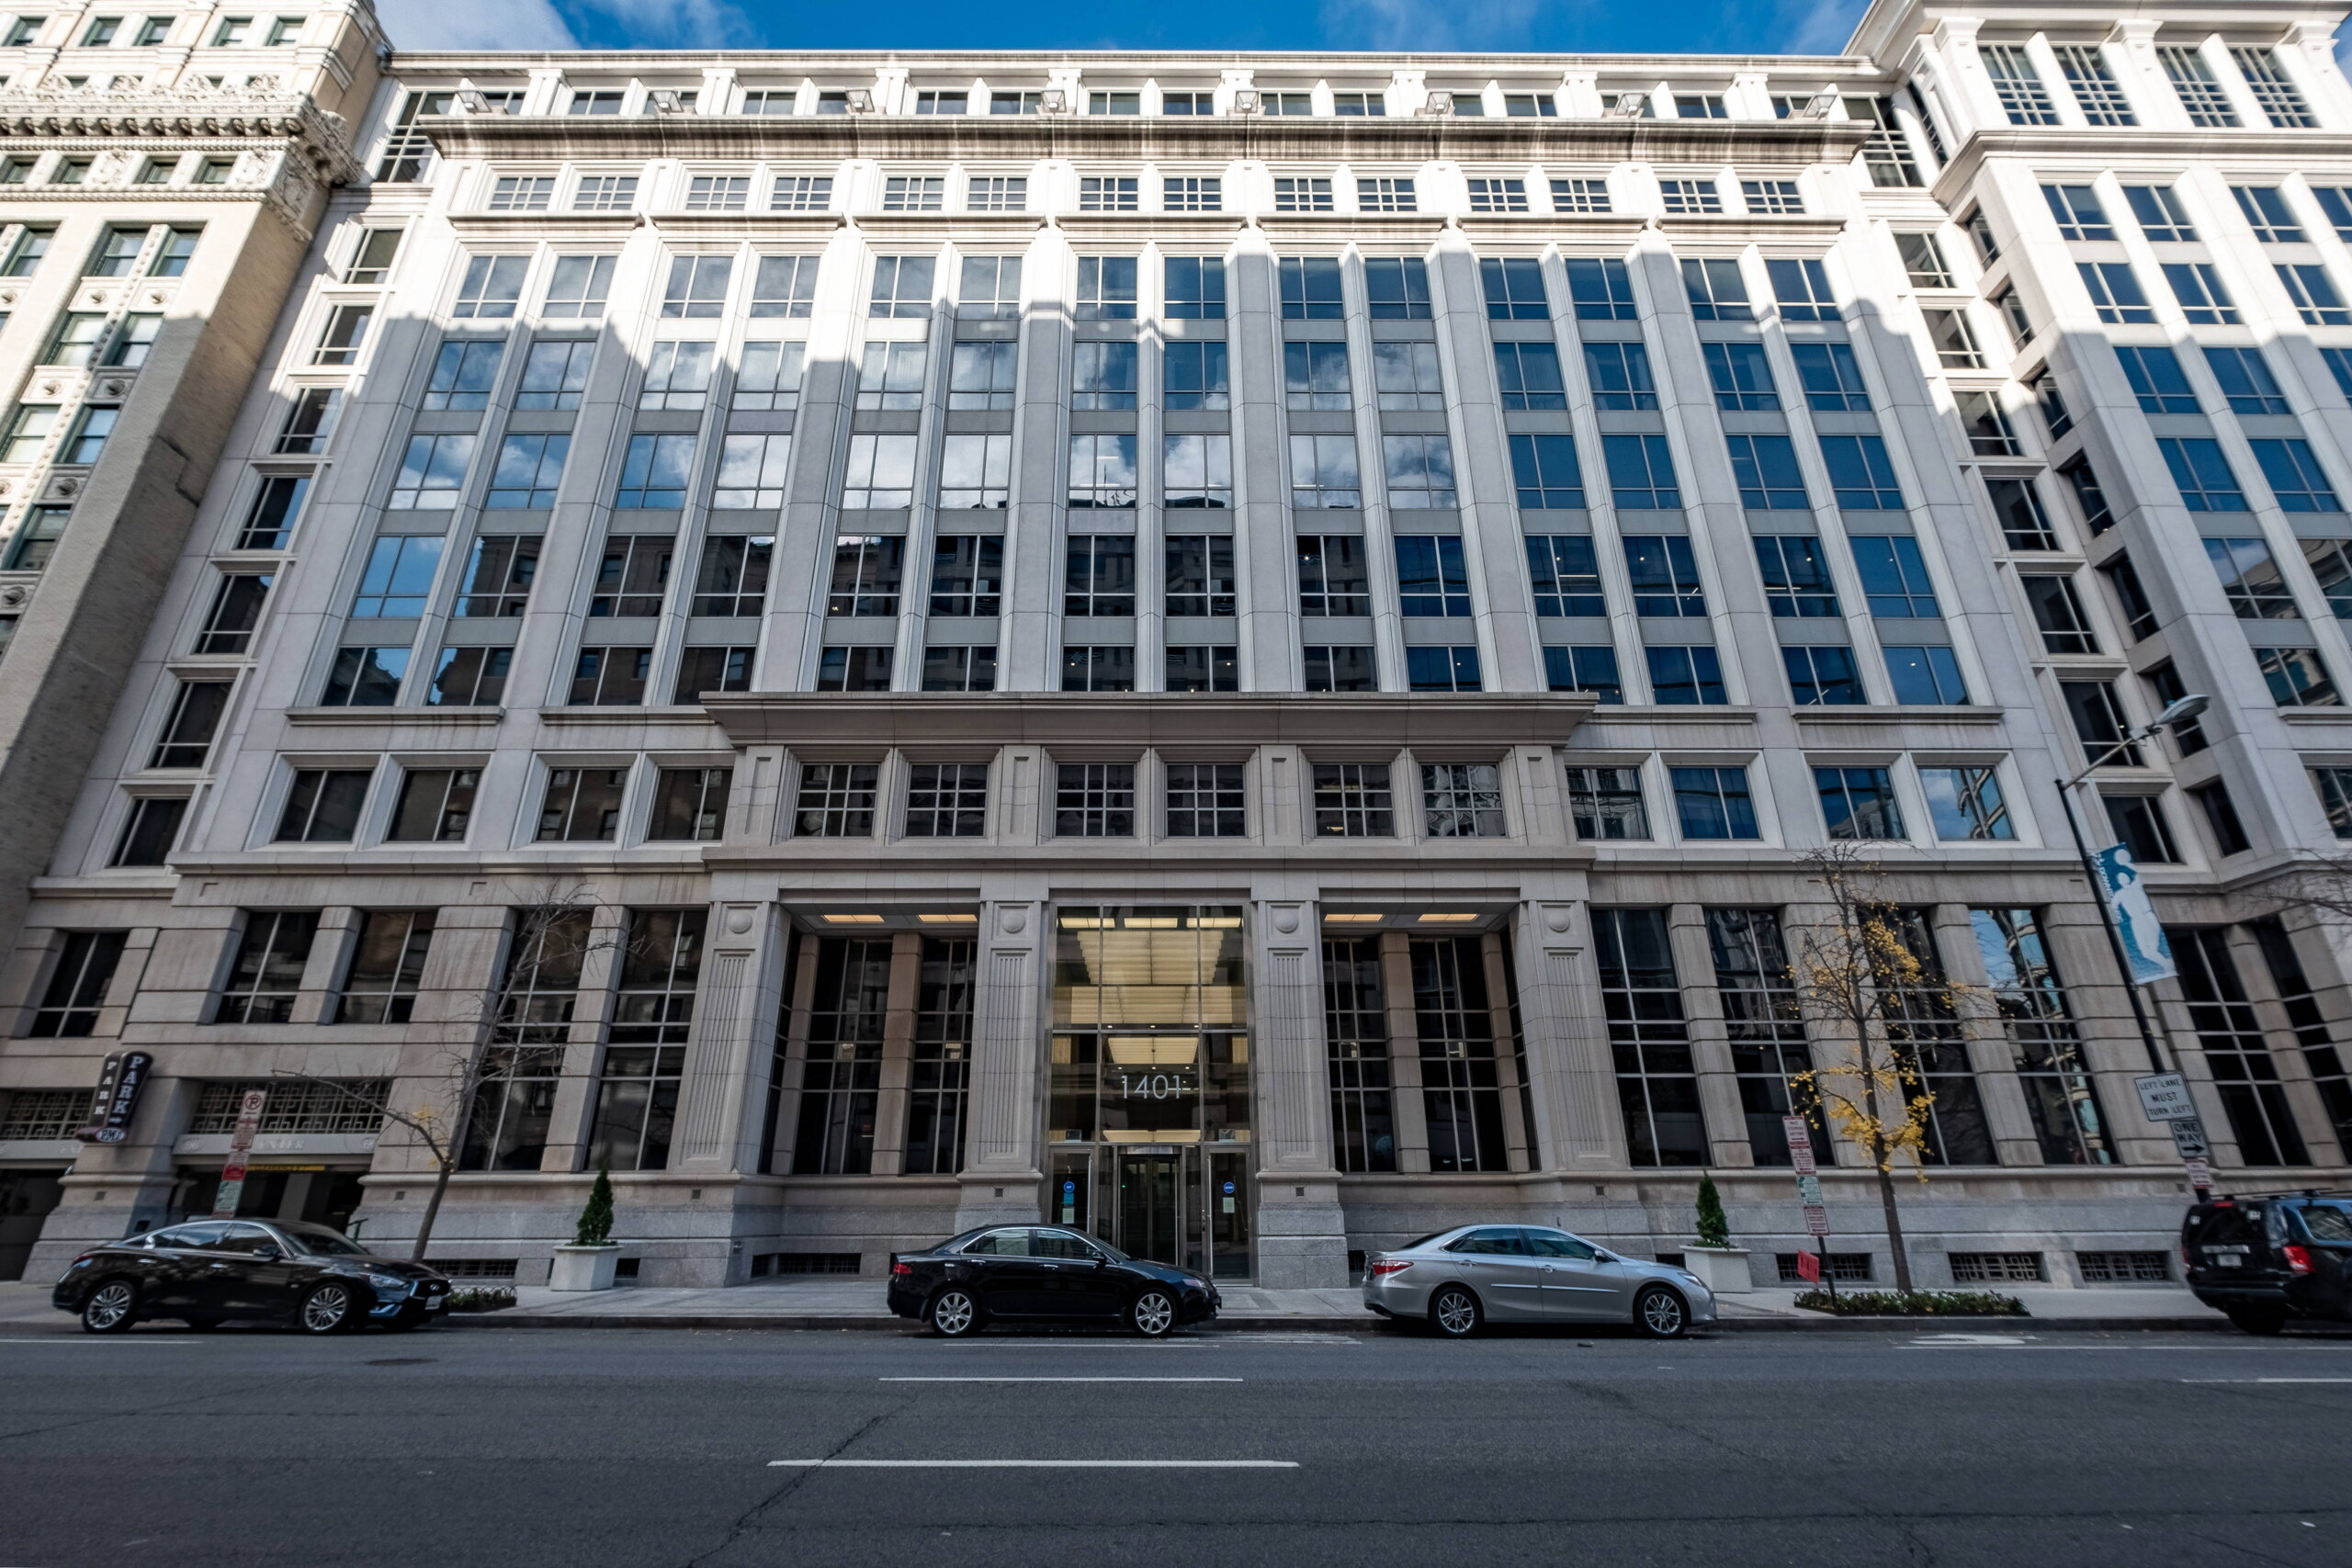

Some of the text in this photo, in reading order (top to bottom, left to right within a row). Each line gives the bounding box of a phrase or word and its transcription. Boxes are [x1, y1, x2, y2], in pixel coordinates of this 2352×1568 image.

[94, 1061, 118, 1115] PARK
[112, 1055, 145, 1114] PARK
[1121, 1074, 1180, 1100] 1401
[2139, 1078, 2181, 1090] LEFT LANE
[2151, 1091, 2178, 1103] MUST
[2148, 1104, 2192, 1116] TURN LEFT
[2175, 1122, 2201, 1133] ONE
[2177, 1133, 2202, 1143] WAY
